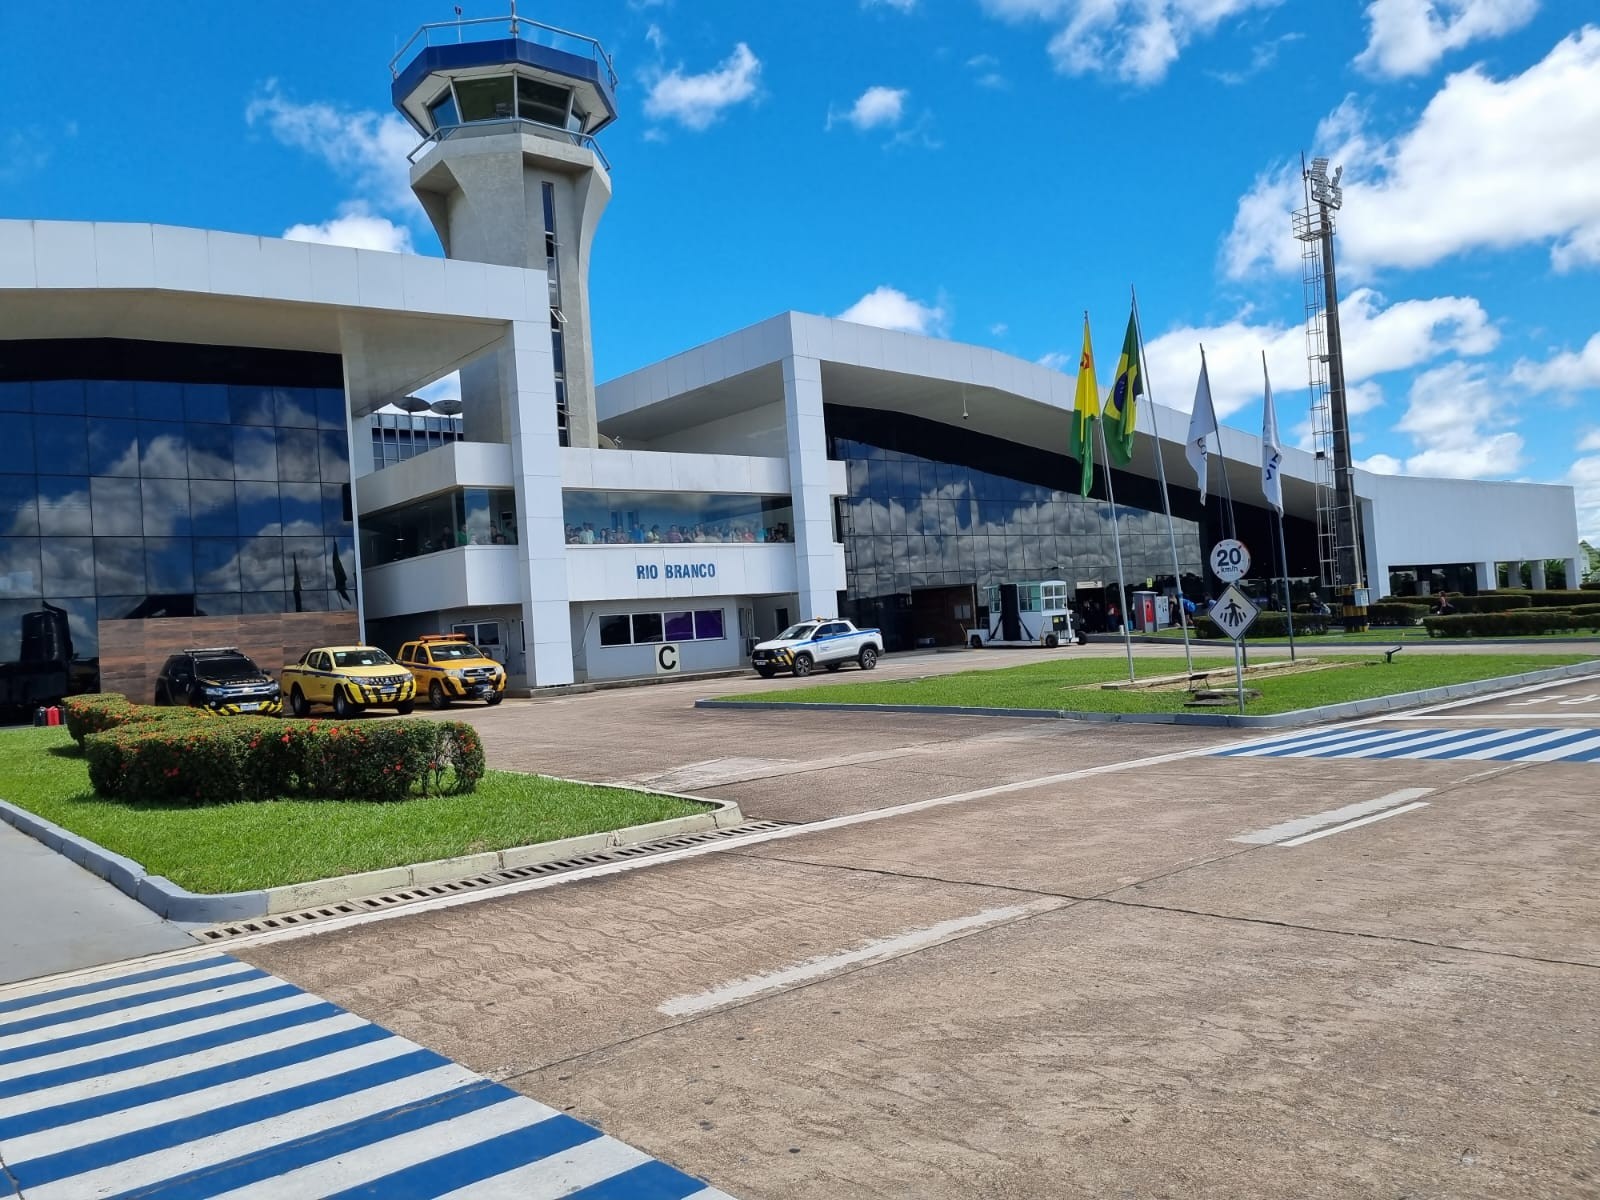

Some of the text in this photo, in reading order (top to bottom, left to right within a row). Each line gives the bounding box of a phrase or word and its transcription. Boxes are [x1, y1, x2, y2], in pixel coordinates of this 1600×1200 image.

[1217, 548, 1241, 566] 20
[636, 563, 716, 579] RIO BRANCO
[659, 645, 676, 670] C
